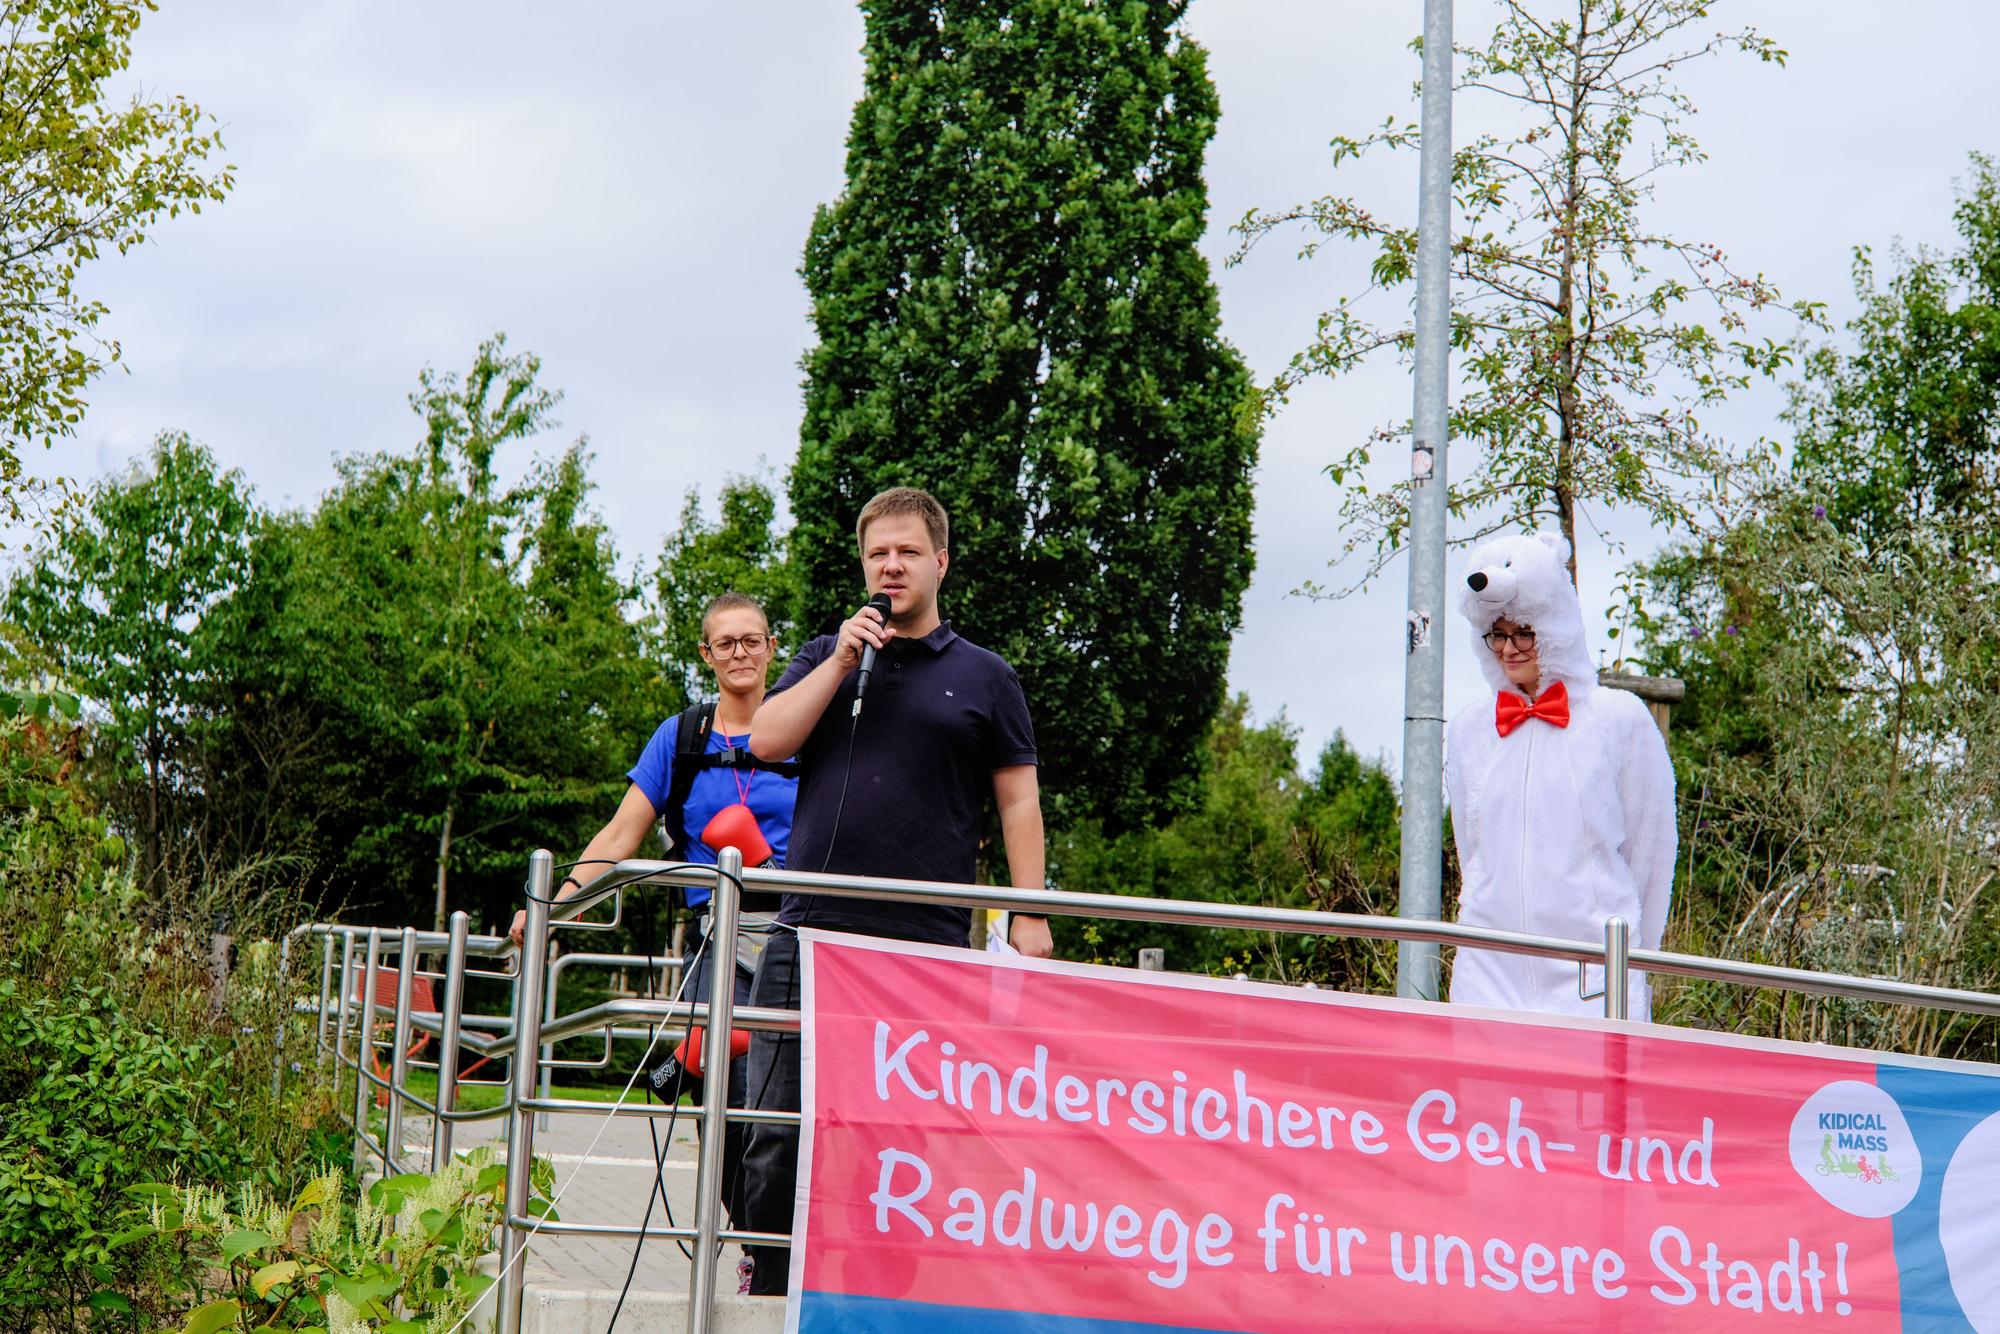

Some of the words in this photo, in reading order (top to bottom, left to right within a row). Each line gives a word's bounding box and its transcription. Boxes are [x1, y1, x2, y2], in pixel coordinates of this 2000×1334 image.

[873, 1020, 1389, 1155] Kindersichere
[1406, 1089, 1576, 1173] Geh-
[1597, 1117, 1720, 1188] und
[1818, 1112, 1887, 1131] KIDICAL
[1838, 1132, 1888, 1153] MASS
[869, 1147, 1234, 1289] Radwege
[1256, 1192, 1368, 1277] für
[1390, 1231, 1628, 1299] unsere
[1649, 1225, 1853, 1316] Stadt!
